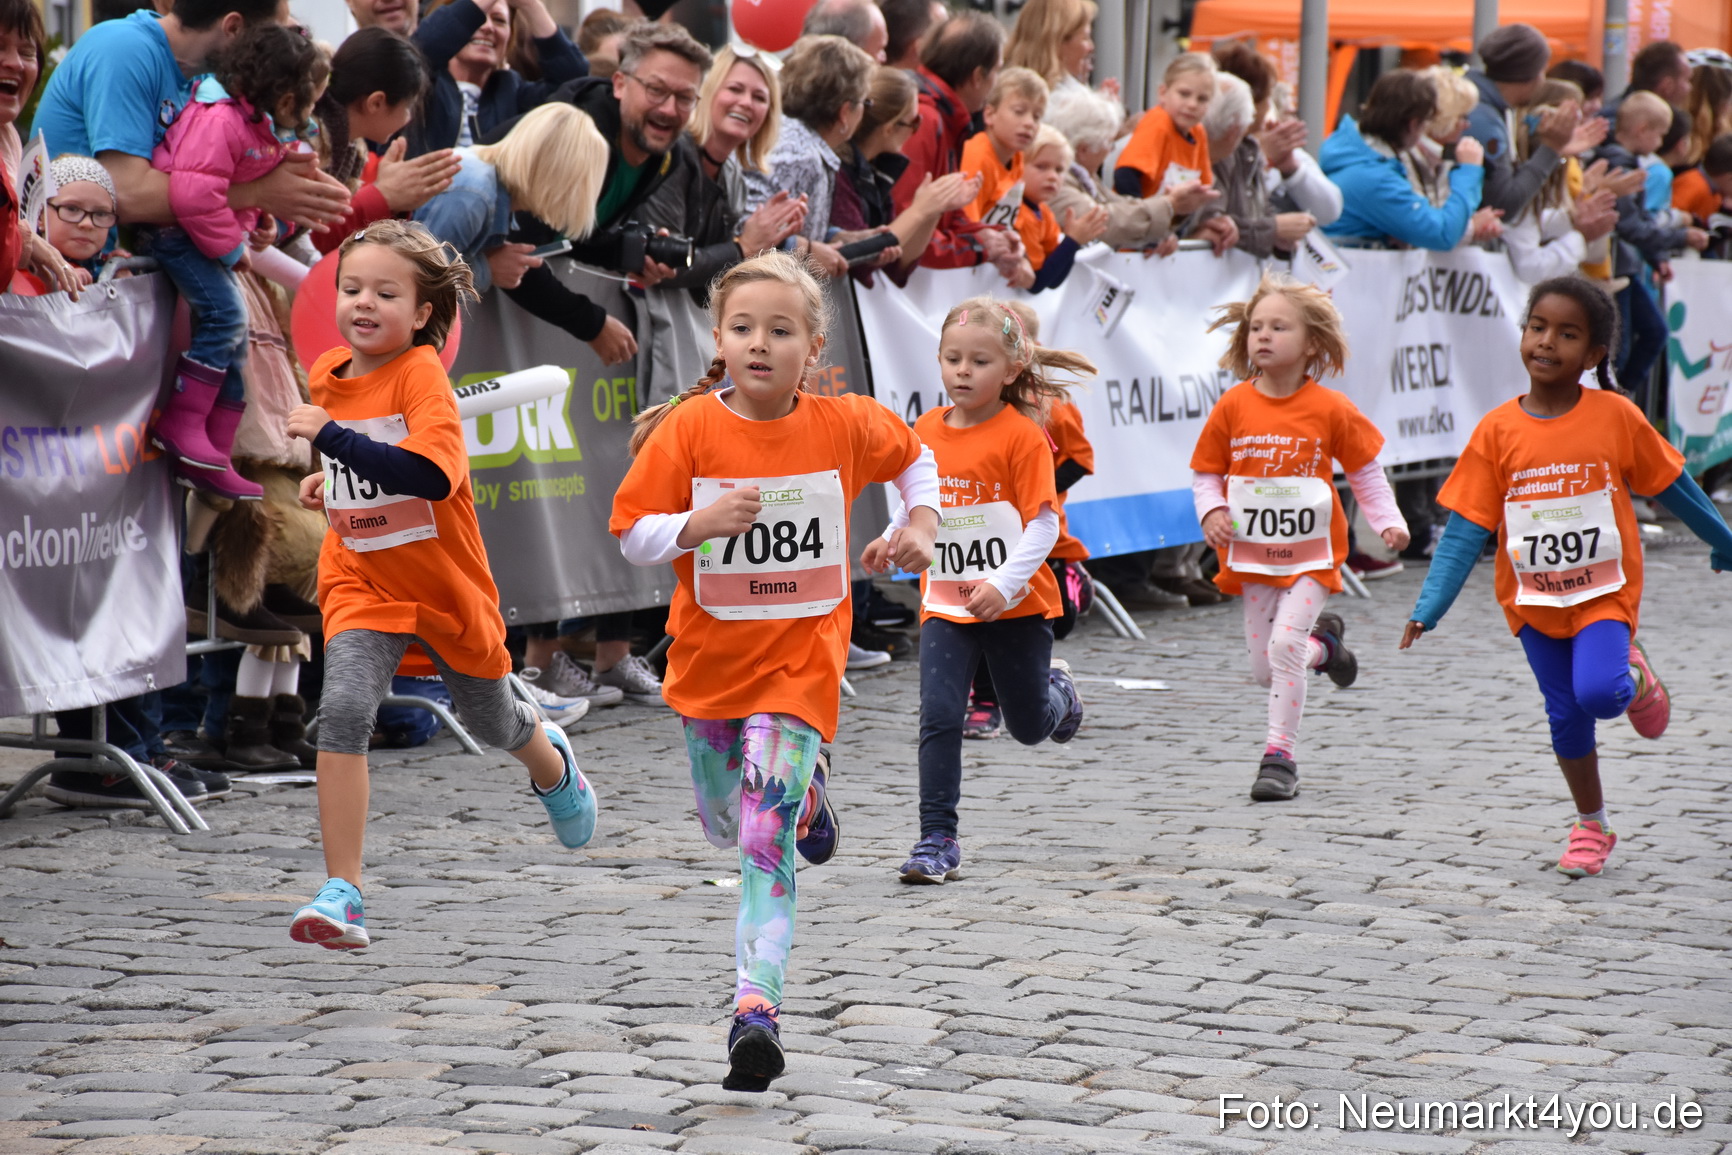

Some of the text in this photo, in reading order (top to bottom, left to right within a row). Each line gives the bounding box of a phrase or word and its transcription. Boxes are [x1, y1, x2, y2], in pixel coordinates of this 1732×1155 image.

[0, 425, 87, 479] STRY
[1231, 447, 1277, 462] Stadtlauf
[1512, 462, 1581, 482] eumarkter
[350, 514, 388, 530] Emma
[1243, 507, 1316, 538] 7050
[721, 516, 824, 566] 7084
[1522, 526, 1601, 567] 7397
[700, 559, 710, 568] B1
[934, 537, 1008, 575] 7040
[1266, 548, 1293, 559] Frida
[749, 580, 798, 595] Emma
[1533, 568, 1594, 593] Shamat
